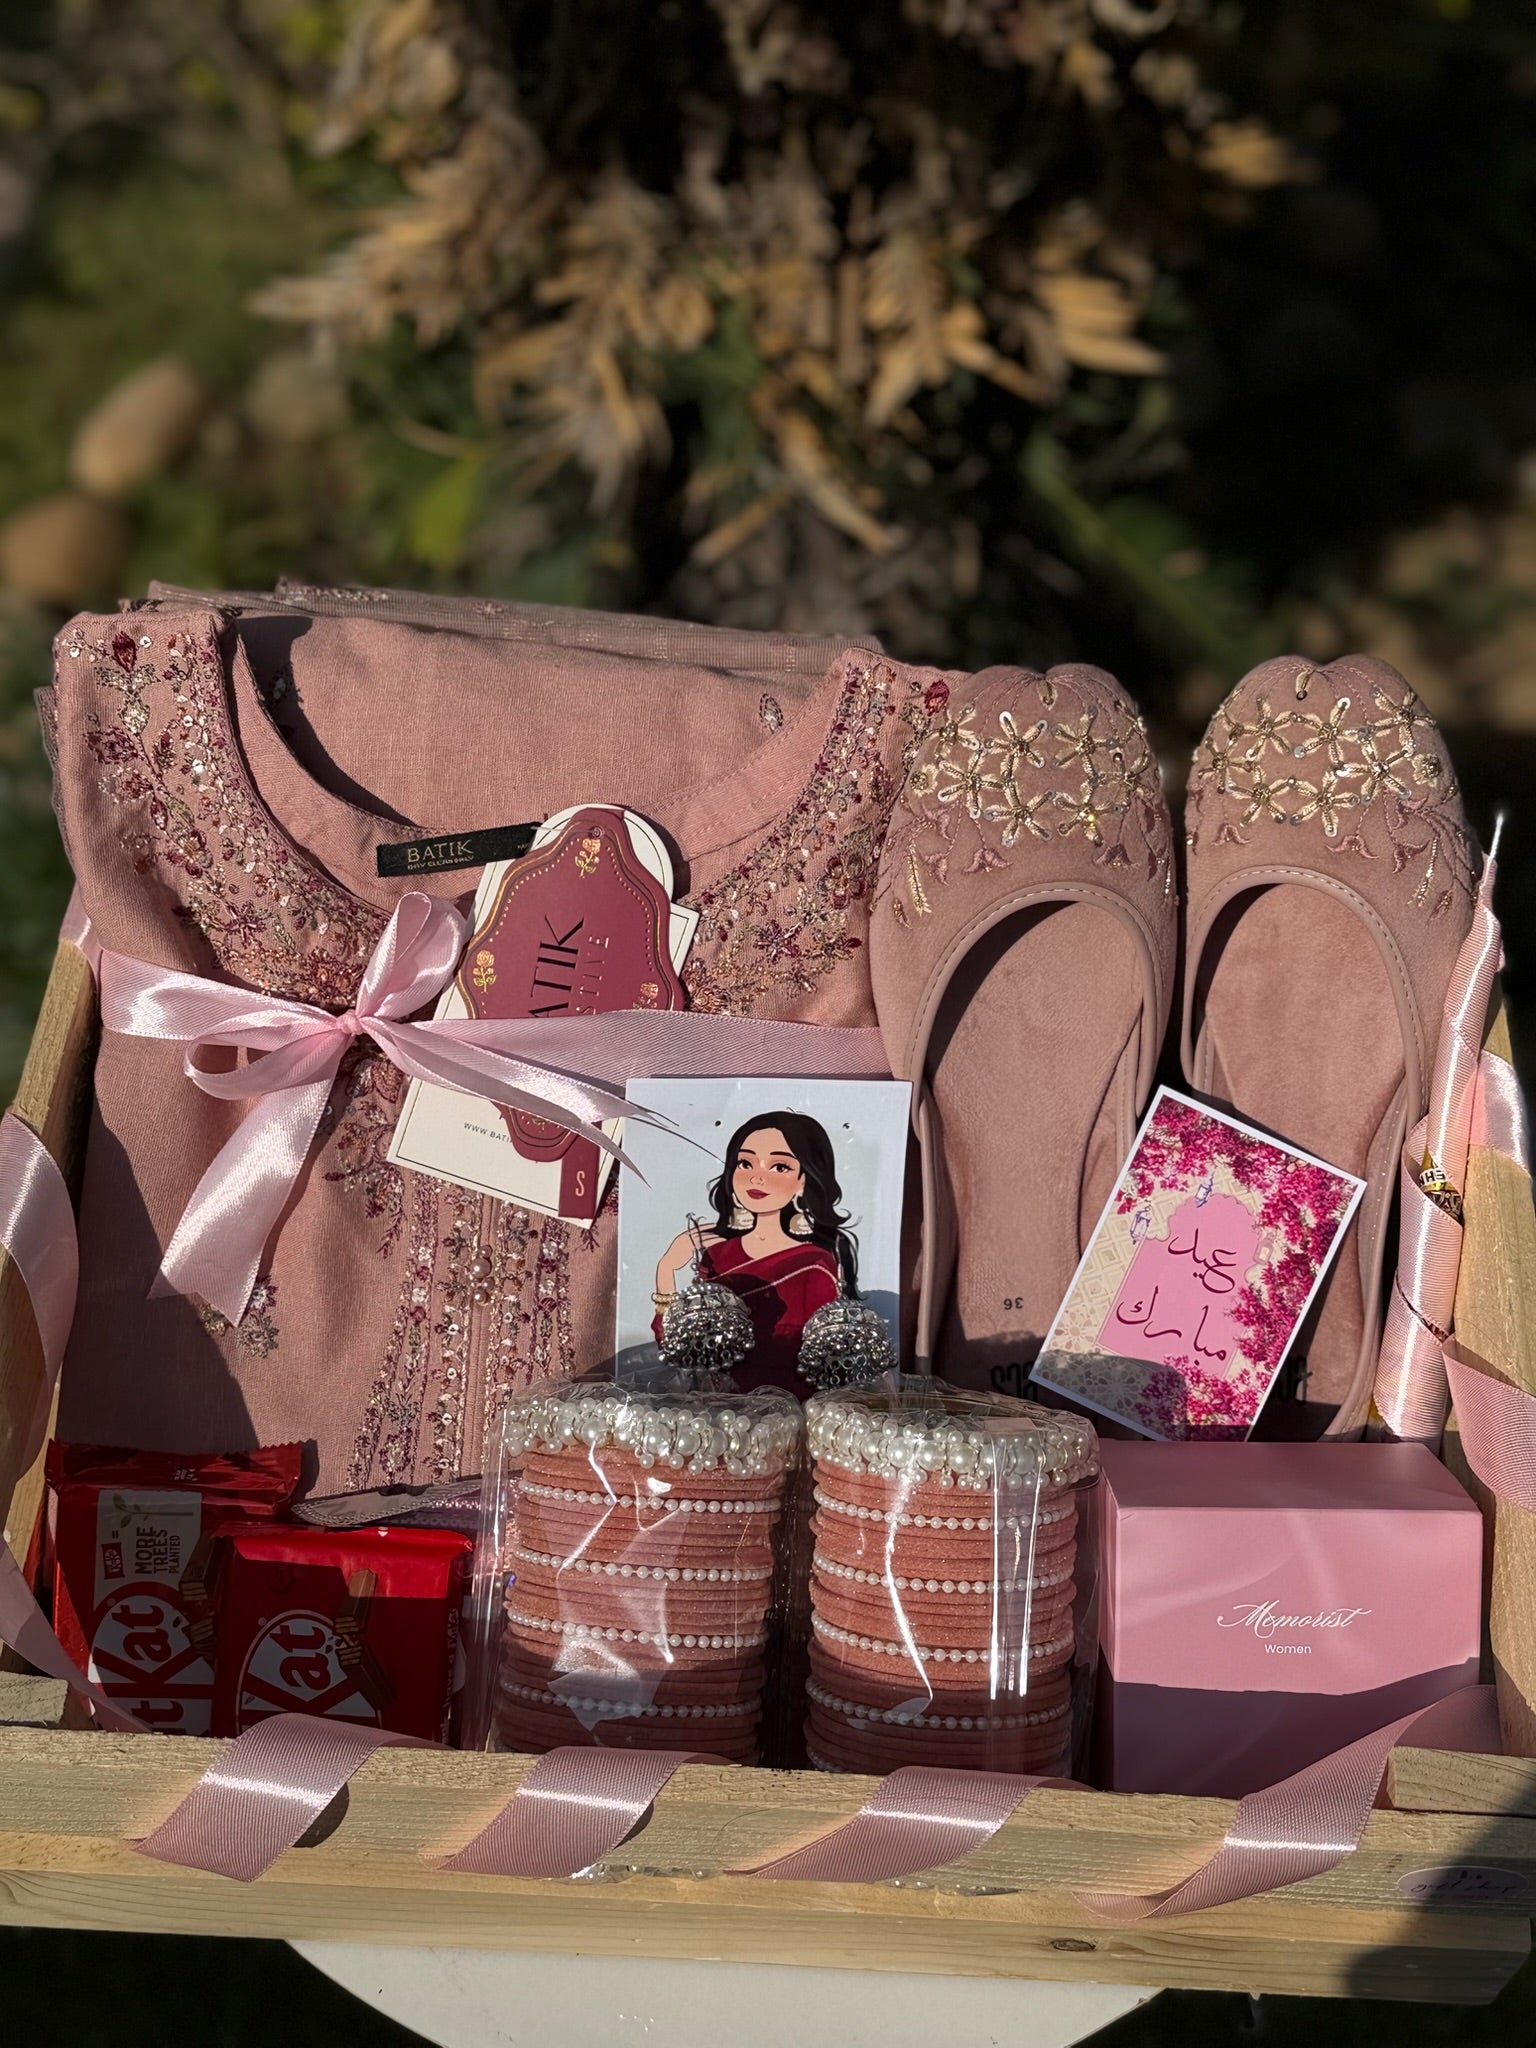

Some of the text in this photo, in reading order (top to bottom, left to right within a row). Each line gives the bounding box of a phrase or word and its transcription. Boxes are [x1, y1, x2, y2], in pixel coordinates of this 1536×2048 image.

[407, 839, 474, 863] BATIK
[528, 913, 585, 1018] ATIK
[575, 1170, 585, 1197] S
[1166, 1227, 1238, 1294] عيد
[1003, 1296, 1024, 1311] 36
[1115, 1285, 1227, 1367] مبارك
[135, 1527, 153, 1575] MORE
[153, 1529, 168, 1574] TREES
[168, 1535, 180, 1574] PLANTED
[1216, 1599, 1373, 1639] Memorist
[1264, 1643, 1312, 1654] Women
